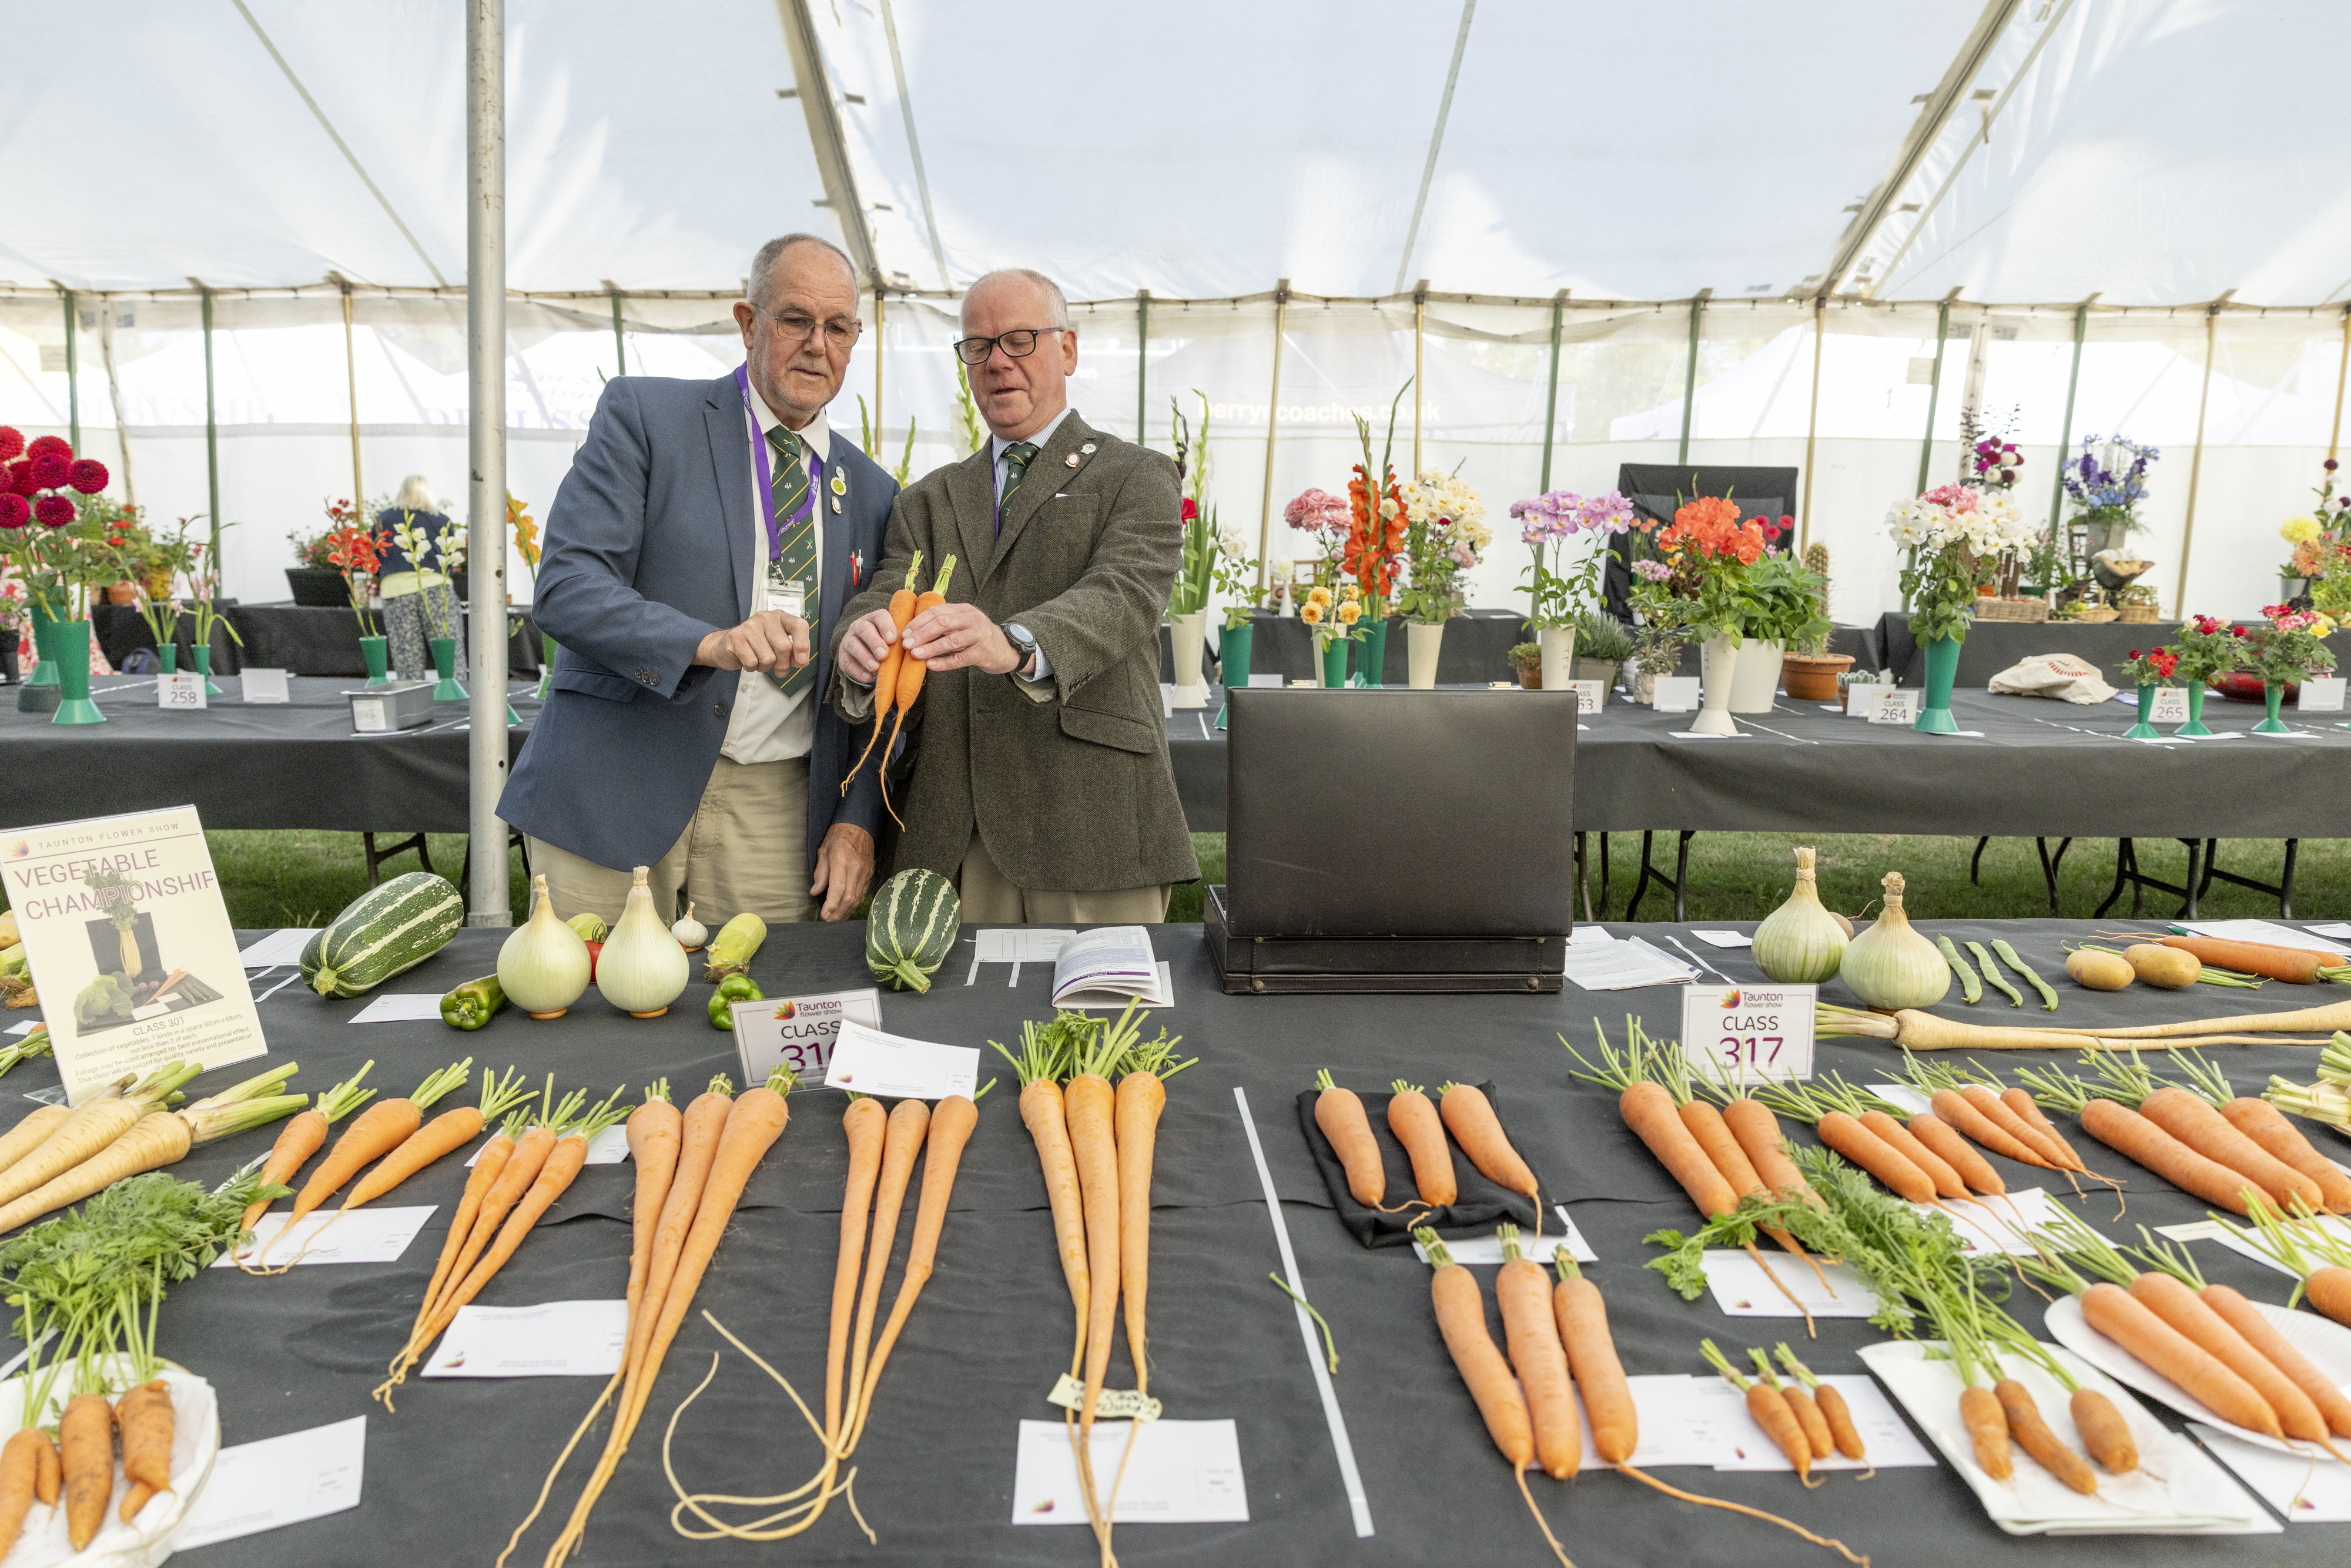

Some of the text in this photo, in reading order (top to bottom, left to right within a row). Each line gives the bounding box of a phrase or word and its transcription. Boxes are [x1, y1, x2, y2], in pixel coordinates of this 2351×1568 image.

[170, 691, 197, 704] 258
[1578, 699, 1593, 710] 63
[1881, 708, 1907, 720] 264
[2157, 706, 2183, 718] 265
[38, 823, 179, 849] TAUNTON FLOWER SHOW
[14, 849, 160, 888] VEGETABLE
[1742, 992, 1783, 1001] Taunton
[796, 1001, 841, 1011] Taunton
[133, 1016, 185, 1036] CLASS 301
[781, 1021, 841, 1038] CLASS
[1723, 1016, 1779, 1031] CLASS
[75, 1048, 107, 1060] Collection
[116, 1038, 151, 1050] vegetables,
[157, 1031, 173, 1039] kinds
[186, 1024, 203, 1033] space
[75, 1066, 99, 1076] Foliage
[125, 1056, 139, 1064] used
[140, 1048, 167, 1060] arranged
[192, 1031, 232, 1047] presentational
[233, 1026, 250, 1035] effect.
[132, 1060, 153, 1071] judged
[163, 1052, 185, 1061] quality,
[185, 1046, 205, 1054] variety
[218, 1034, 253, 1047] presentation
[1719, 1037, 1783, 1070] 317
